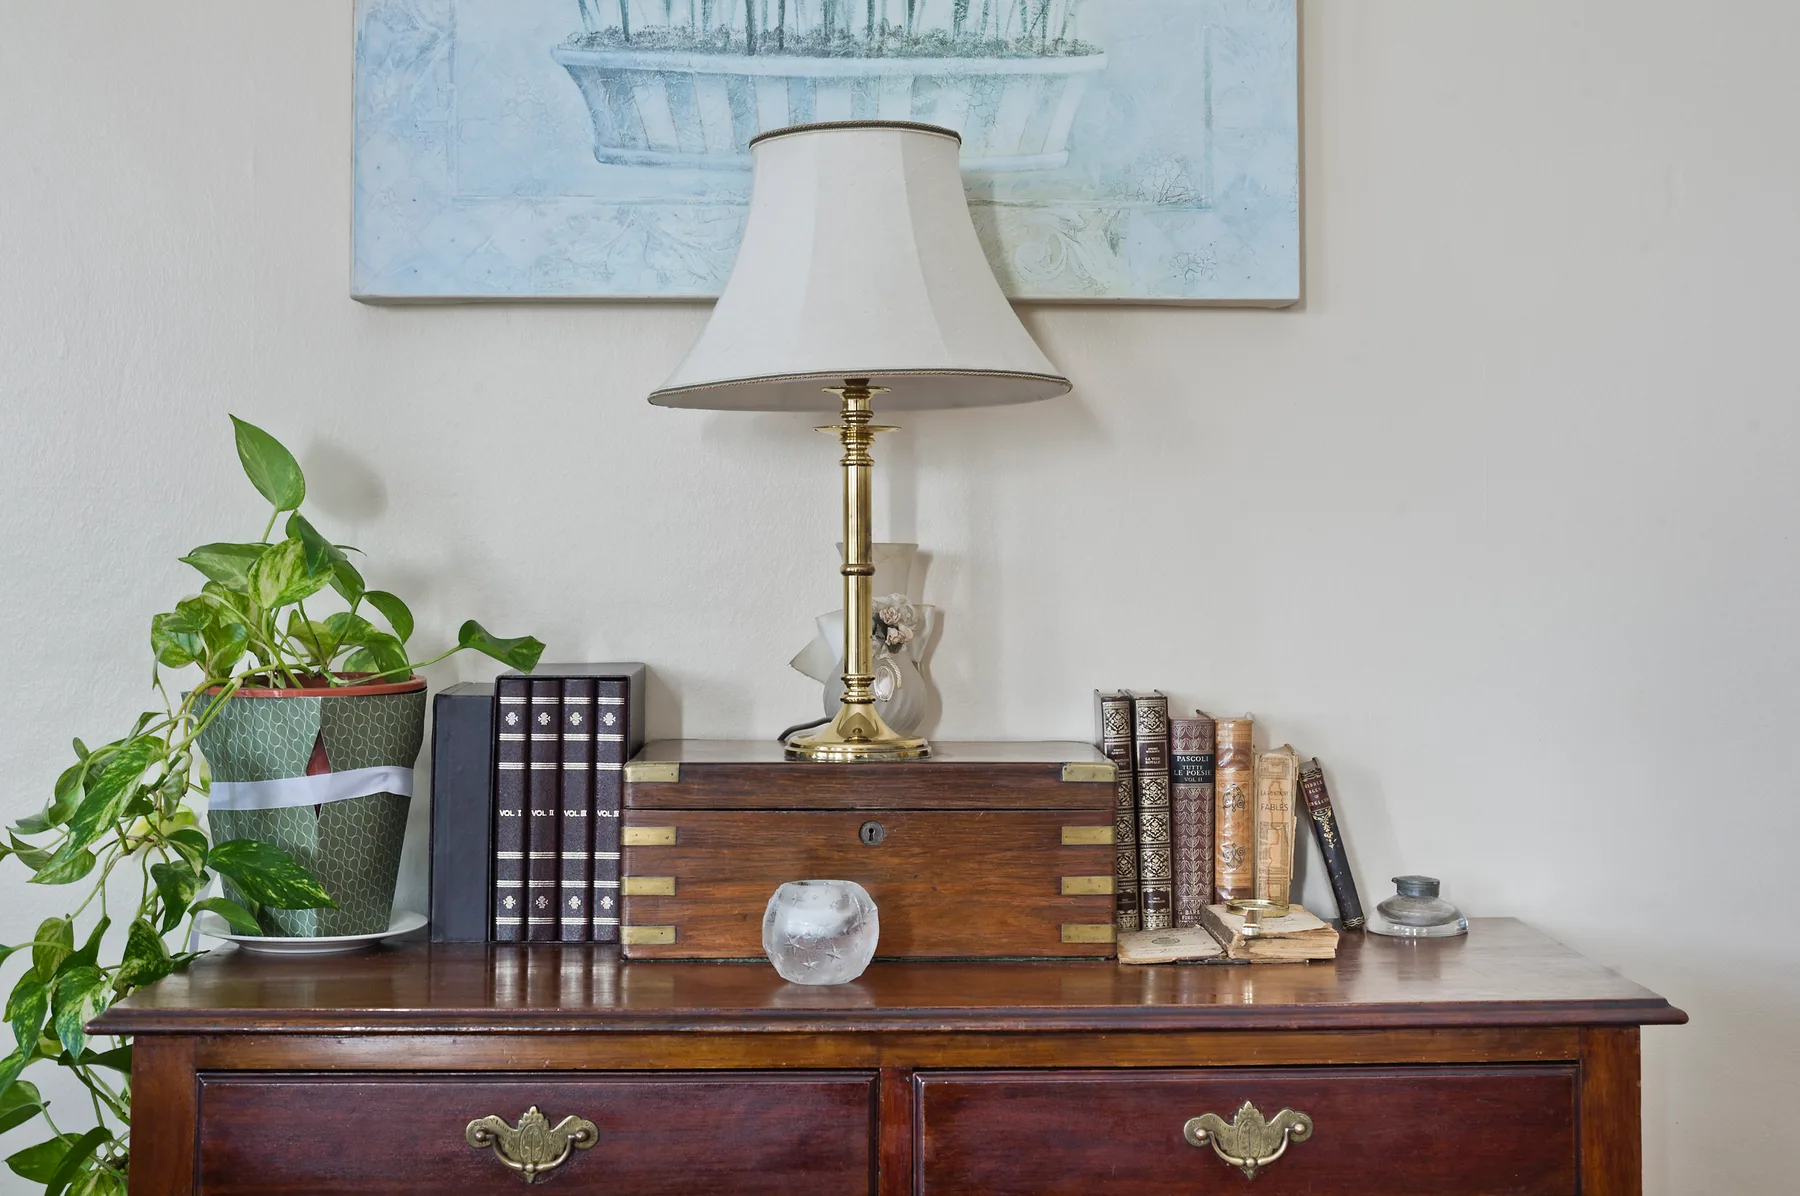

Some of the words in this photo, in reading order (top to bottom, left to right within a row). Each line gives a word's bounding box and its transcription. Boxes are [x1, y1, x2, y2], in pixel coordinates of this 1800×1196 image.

[1260, 803, 1289, 811] FABLES
[499, 809, 515, 817] VOL
[517, 809, 522, 817] I
[531, 809, 547, 817] VOL
